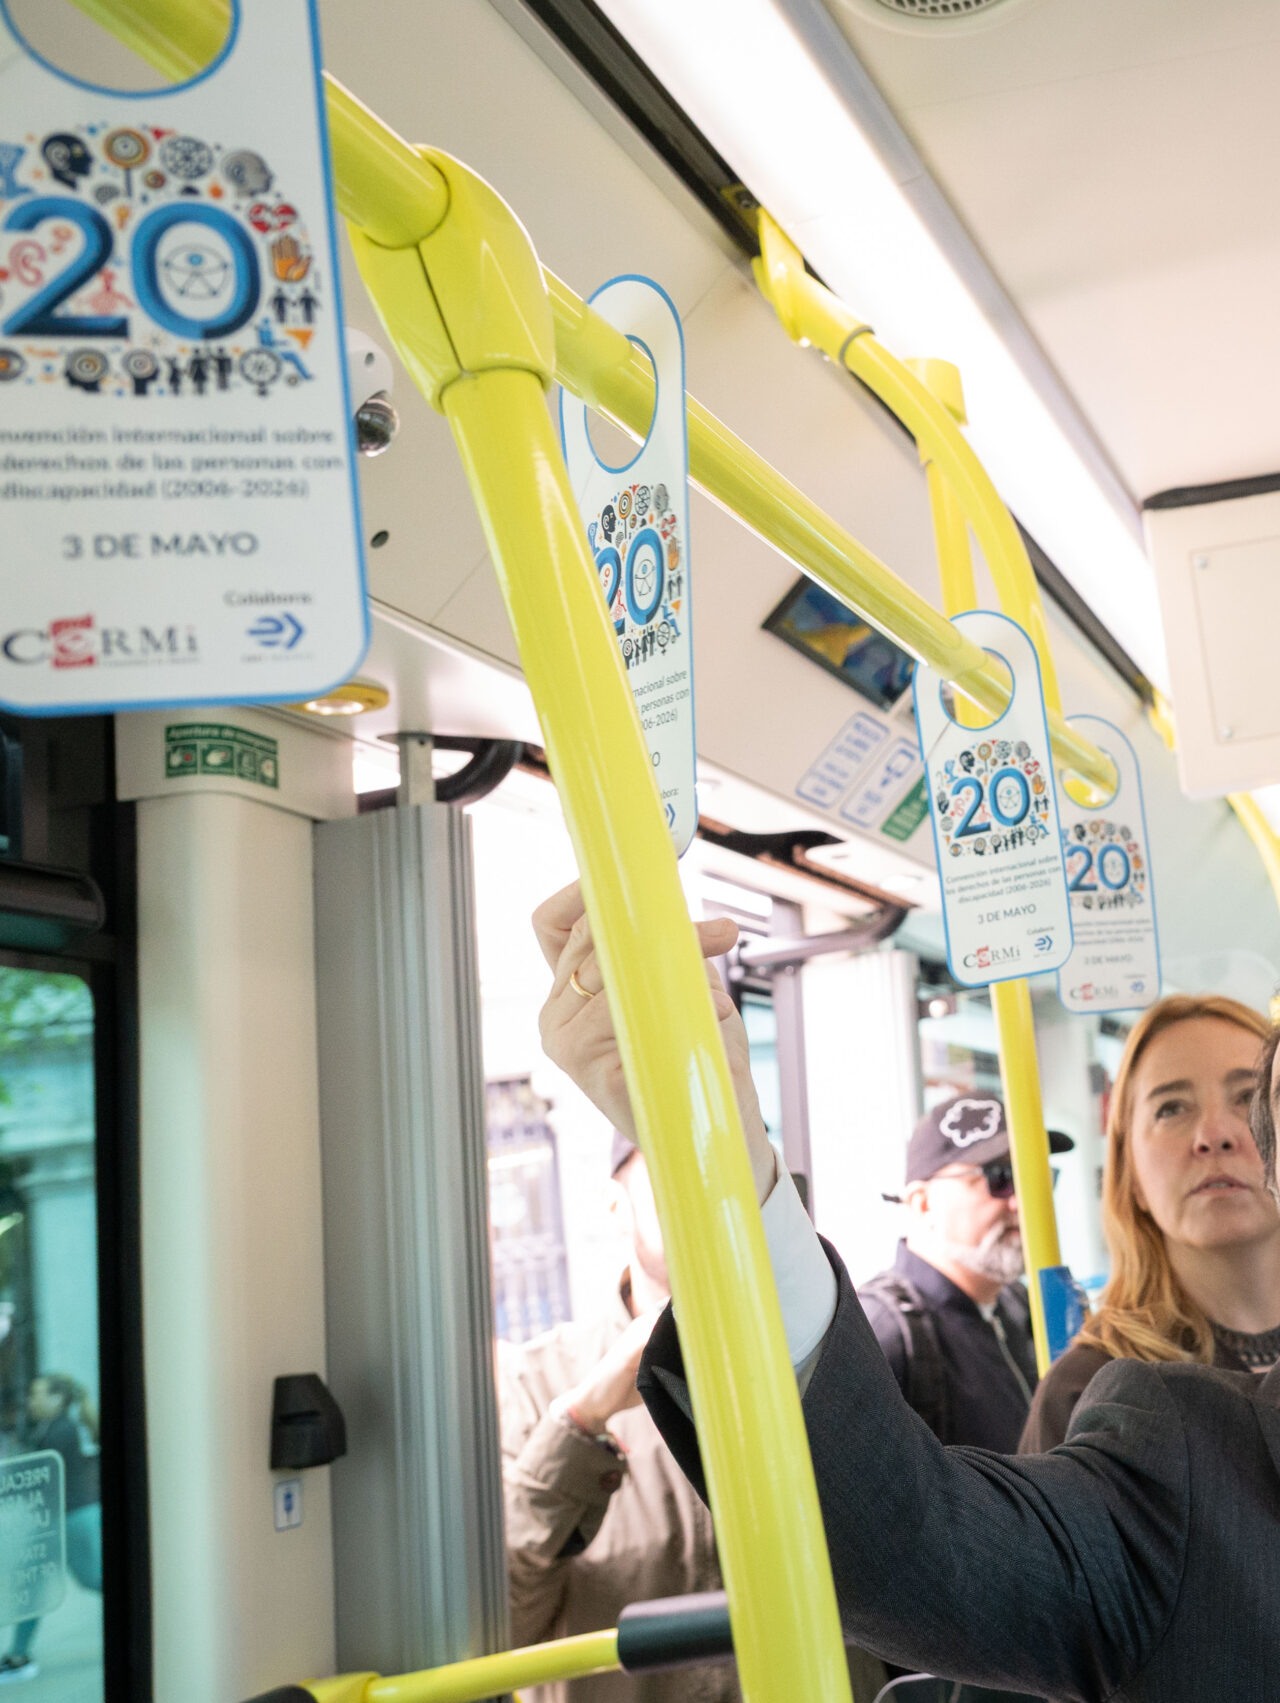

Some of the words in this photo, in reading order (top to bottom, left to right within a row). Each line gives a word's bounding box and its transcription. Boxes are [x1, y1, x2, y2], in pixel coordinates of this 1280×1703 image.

[2, 196, 262, 341] 20
[112, 424, 266, 445] internacional
[272, 425, 334, 444] sobre
[2, 452, 110, 472] derechos
[117, 452, 146, 471] de
[152, 452, 184, 471] las
[192, 456, 295, 474] personas
[302, 456, 345, 471] con
[3, 480, 157, 502] discapacidad
[161, 477, 310, 501] (2006-2026)
[62, 536, 85, 561] 3
[94, 533, 143, 559] DE
[150, 531, 260, 557] MAYO
[666, 670, 687, 686] sobre
[641, 694, 674, 715] personas
[675, 688, 689, 700] con
[951, 767, 1031, 839] 20
[946, 869, 988, 884] Convención
[989, 858, 1037, 875] internacional
[1038, 854, 1058, 865] sobre
[958, 880, 990, 893] derechos
[991, 878, 1000, 886] de
[1002, 875, 1012, 883] las
[1014, 868, 1047, 882] personas
[1048, 865, 1062, 874] con
[1067, 844, 1131, 892] 20
[959, 887, 1004, 904] discapacidad
[978, 914, 985, 925] 3
[987, 909, 1001, 922] DE
[1003, 904, 1037, 919] MAYO
